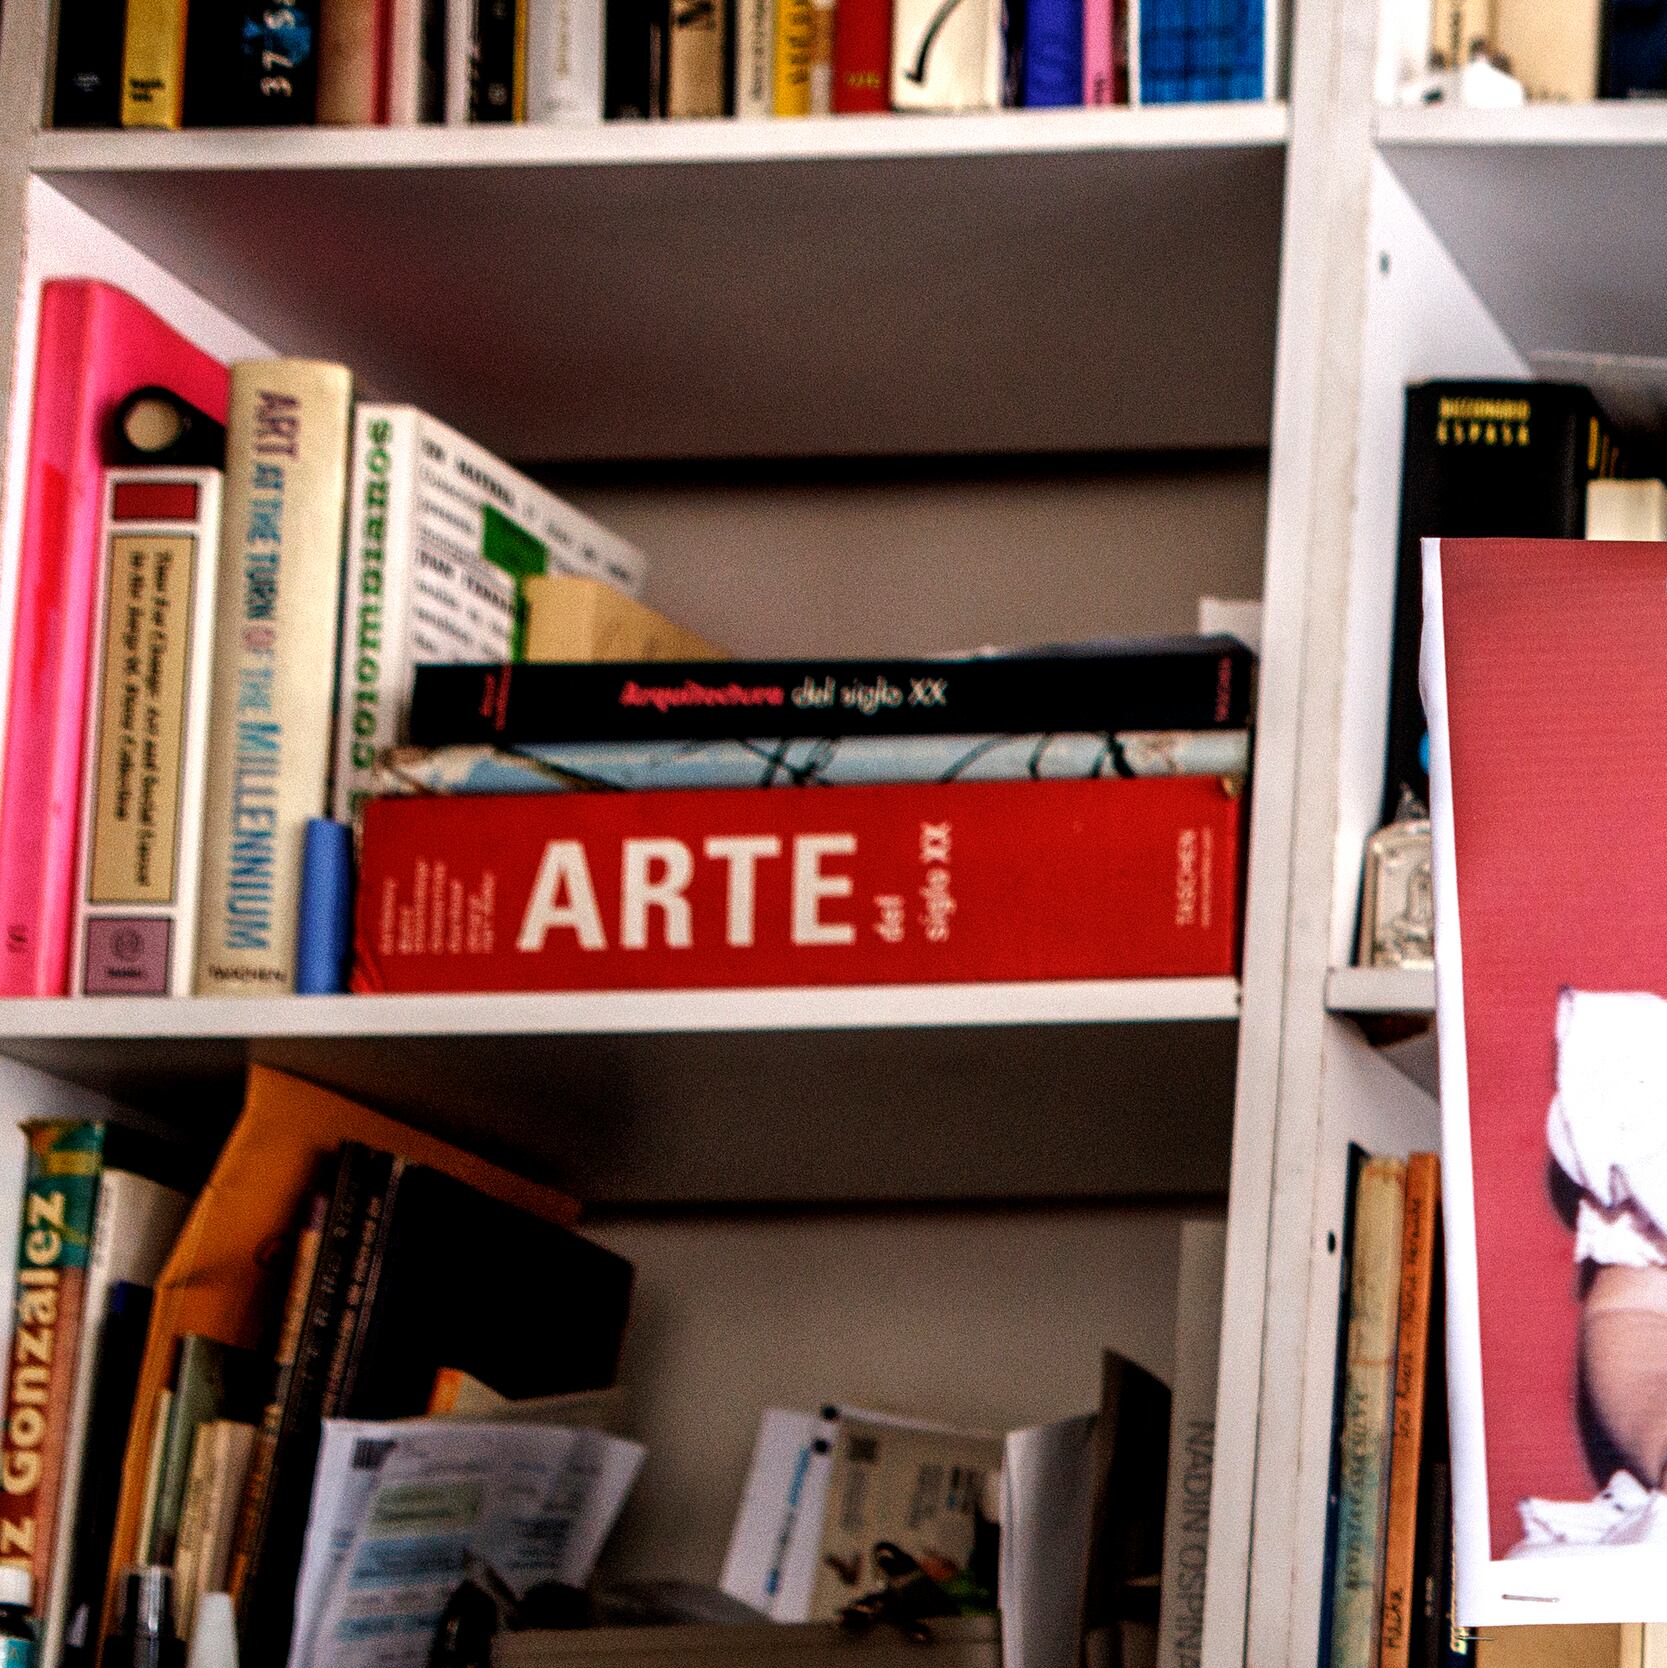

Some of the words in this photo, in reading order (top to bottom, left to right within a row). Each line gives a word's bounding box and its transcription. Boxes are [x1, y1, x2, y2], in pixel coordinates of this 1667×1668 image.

[255, 389, 297, 460] ART
[252, 462, 284, 492] AT
[245, 498, 283, 544] THE
[244, 552, 280, 620] TURN
[238, 667, 275, 714] THE
[620, 679, 787, 712] Arquitectura
[793, 677, 839, 707] del
[843, 678, 903, 714] siglo
[906, 677, 949, 705] XX
[225, 719, 284, 950] MILLENNIUM
[919, 820, 951, 863] XX
[518, 832, 858, 953] ARTE
[873, 893, 907, 942] del
[919, 865, 956, 942] siglo
[0, 1191, 65, 1496] González
[1181, 1420, 1216, 1533] NADIN
